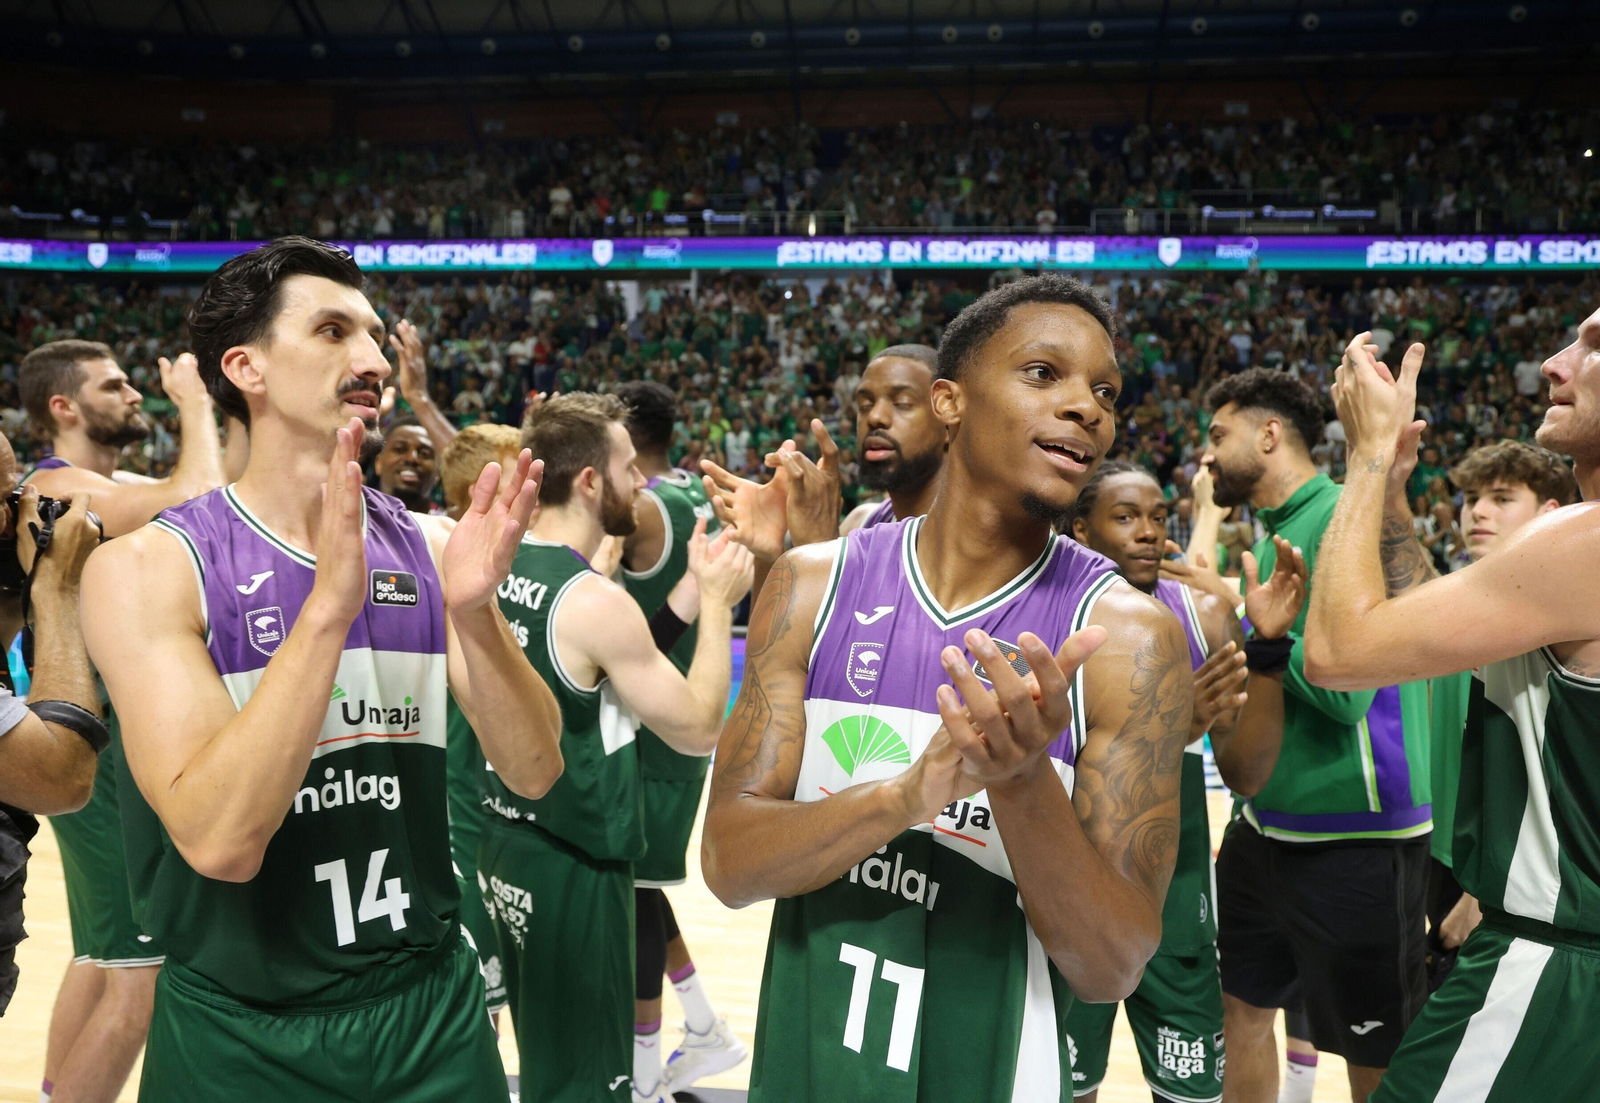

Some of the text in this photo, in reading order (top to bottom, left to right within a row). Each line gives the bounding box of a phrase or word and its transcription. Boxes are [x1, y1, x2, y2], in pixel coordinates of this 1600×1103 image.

[353, 245, 384, 266] EN
[889, 241, 922, 263] EN
[1494, 241, 1531, 264] EN
[376, 580, 395, 592] liga
[376, 591, 416, 603] endesa
[341, 696, 420, 732] Unaja
[314, 848, 411, 947] 14
[838, 942, 925, 1073] 11
